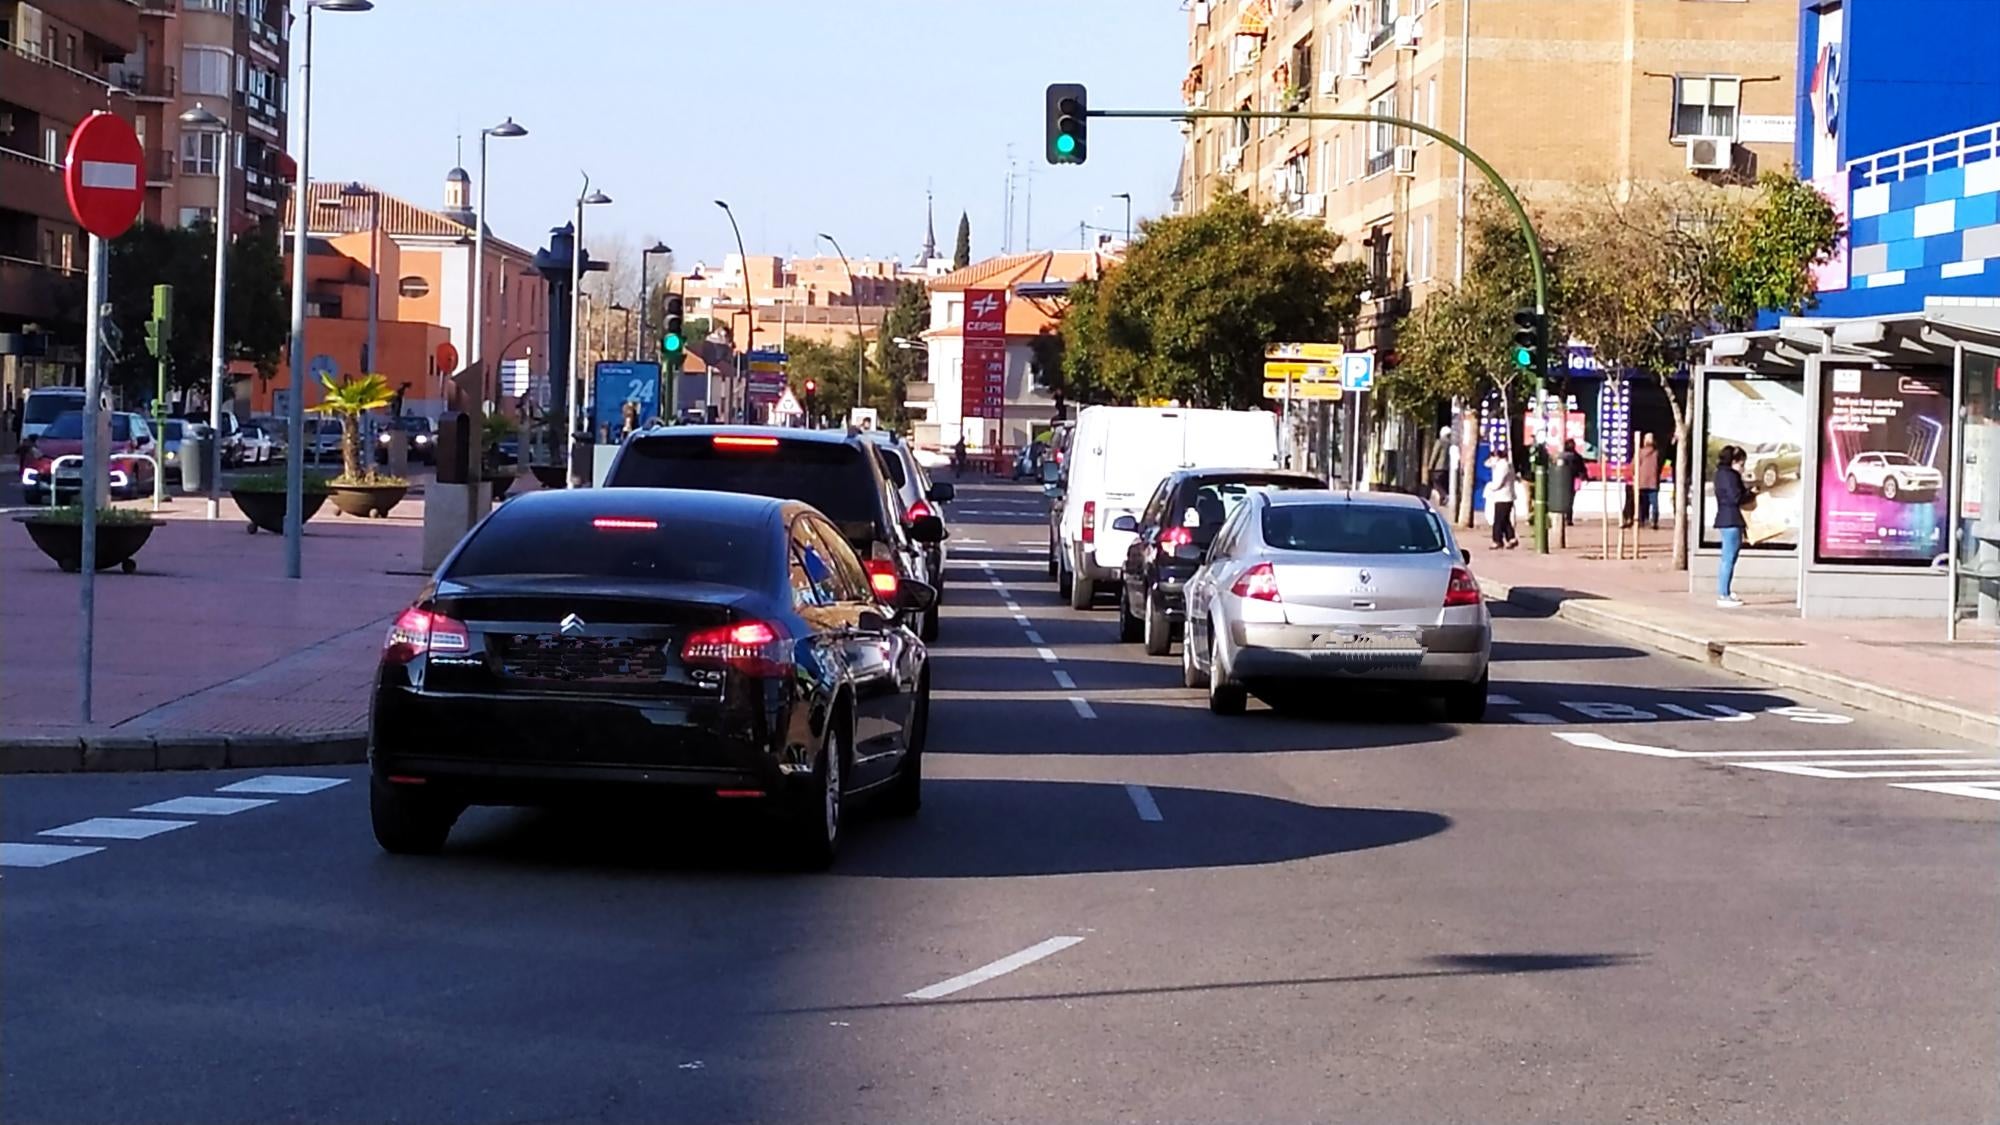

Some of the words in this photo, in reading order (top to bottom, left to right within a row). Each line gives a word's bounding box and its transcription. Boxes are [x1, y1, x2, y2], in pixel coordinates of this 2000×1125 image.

[966, 321, 1003, 331] CEPSA
[1347, 357, 1369, 387] P
[627, 379, 655, 402] 24
[691, 669, 722, 681] C5
[1559, 701, 1854, 724] BUS
